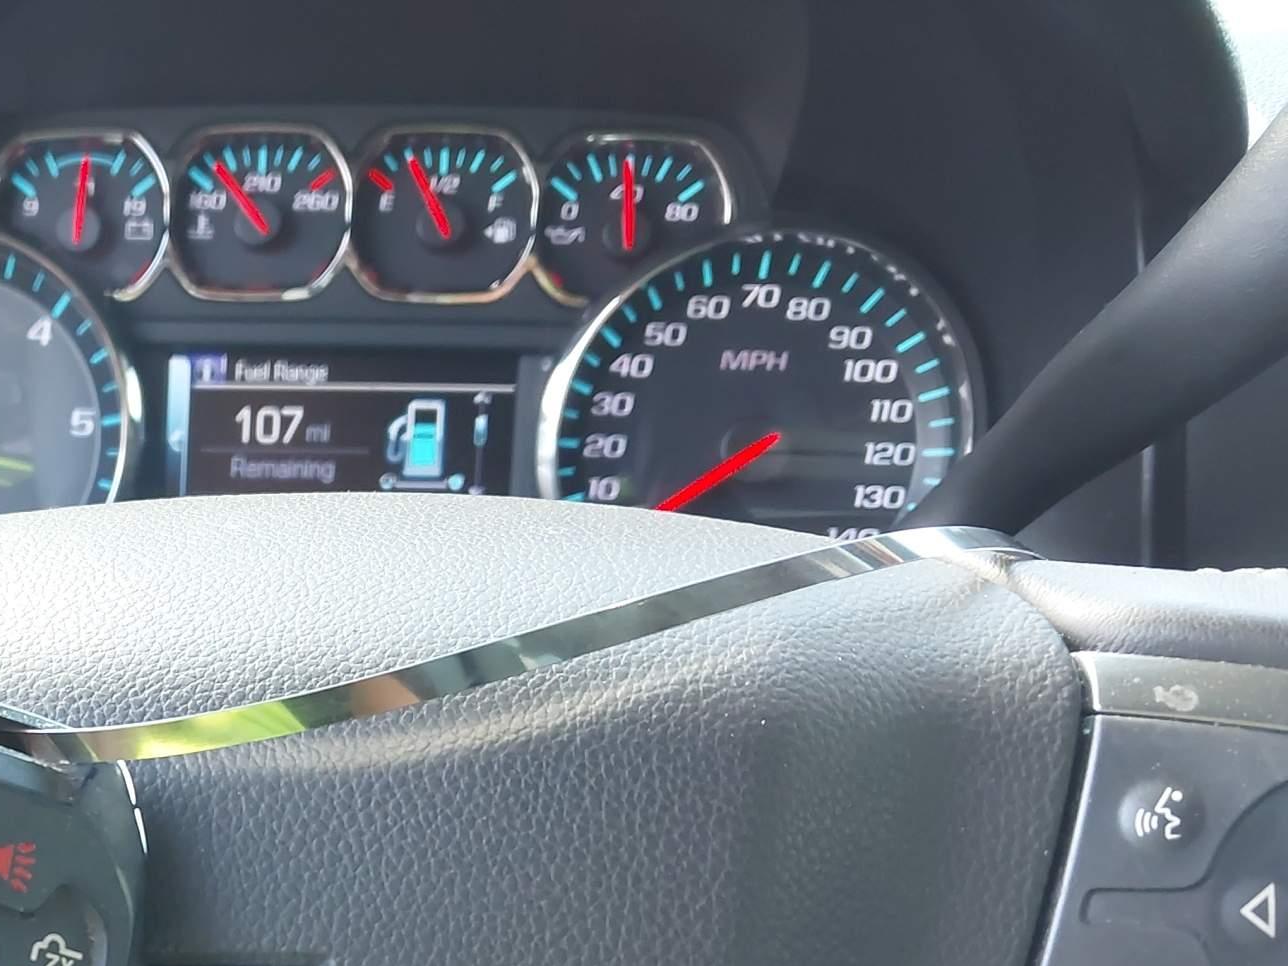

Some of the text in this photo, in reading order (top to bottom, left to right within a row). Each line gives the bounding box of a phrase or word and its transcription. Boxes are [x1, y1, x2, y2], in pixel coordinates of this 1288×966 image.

[22, 197, 39, 217] 9
[379, 193, 395, 212] E
[488, 193, 504, 212] F
[560, 202, 580, 220] 0
[664, 203, 698, 222] 80
[686, 295, 732, 321] 60
[741, 283, 782, 309] 70
[785, 296, 831, 322] 80
[26, 319, 53, 346] 4
[644, 321, 688, 347] 50
[828, 326, 872, 351] 90
[235, 359, 329, 386] Fuel Range
[609, 353, 654, 379] 40
[720, 349, 789, 372] MPH
[843, 358, 899, 384] 100
[590, 391, 635, 417] 30
[869, 398, 913, 424] 110
[69, 409, 97, 437] 5
[235, 404, 332, 445] 107 mi
[583, 433, 627, 459] 20
[863, 440, 916, 466] 120
[229, 456, 337, 484] Remaining
[587, 475, 621, 500] 10
[853, 484, 906, 510] 130
